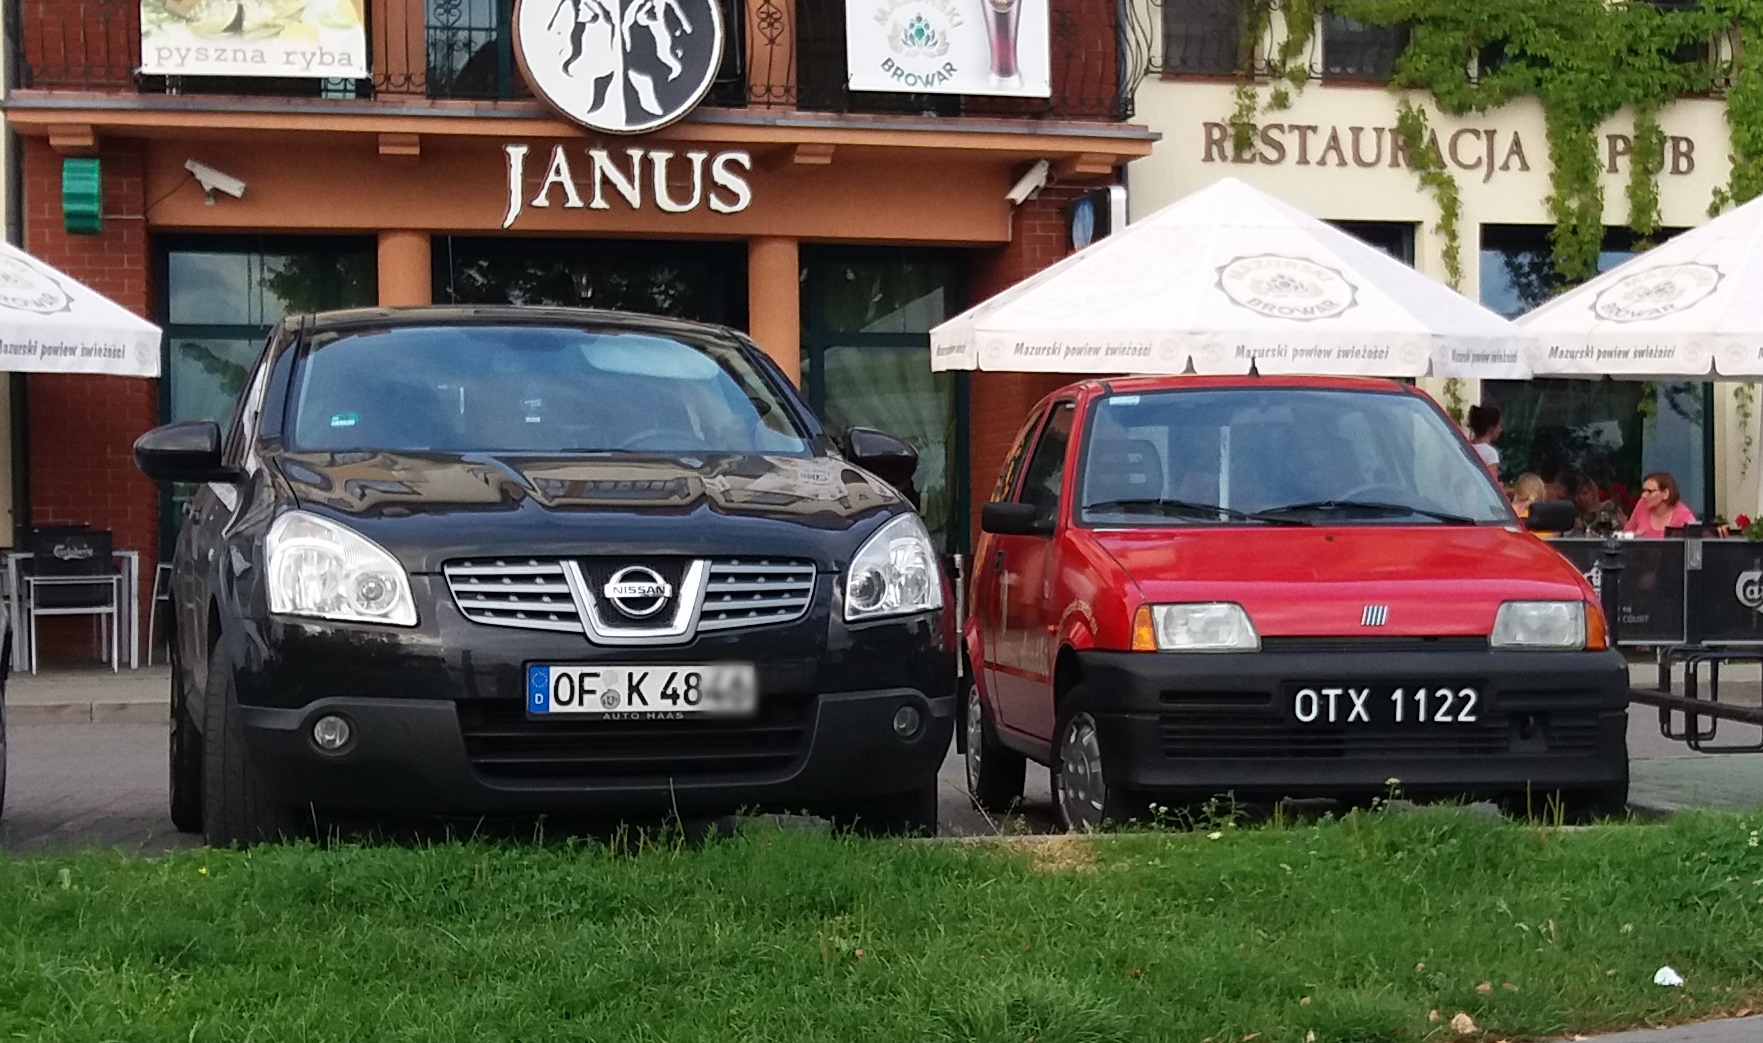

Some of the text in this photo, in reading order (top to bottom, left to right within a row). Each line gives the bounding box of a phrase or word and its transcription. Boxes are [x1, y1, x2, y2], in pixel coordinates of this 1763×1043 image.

[155, 46, 353, 71] pyszna ryba
[880, 57, 958, 88] BROWAR
[502, 144, 752, 229] JANUS
[1246, 298, 1340, 315] BROWAR
[40, 341, 77, 361] powiew
[1013, 341, 1062, 356] Mazurski
[1063, 342, 1102, 360] powiew
[1235, 344, 1288, 359] Mazurski
[1292, 345, 1333, 362] powiew
[1548, 345, 1595, 360] Mazurski
[1596, 346, 1631, 363] powiew
[613, 586, 665, 594] NISSAN
[535, 693, 544, 704] D
[553, 672, 600, 707] OF
[627, 672, 649, 706] K
[1295, 688, 1478, 722] OTX 1122
[603, 712, 684, 720] AUTO HAAS
